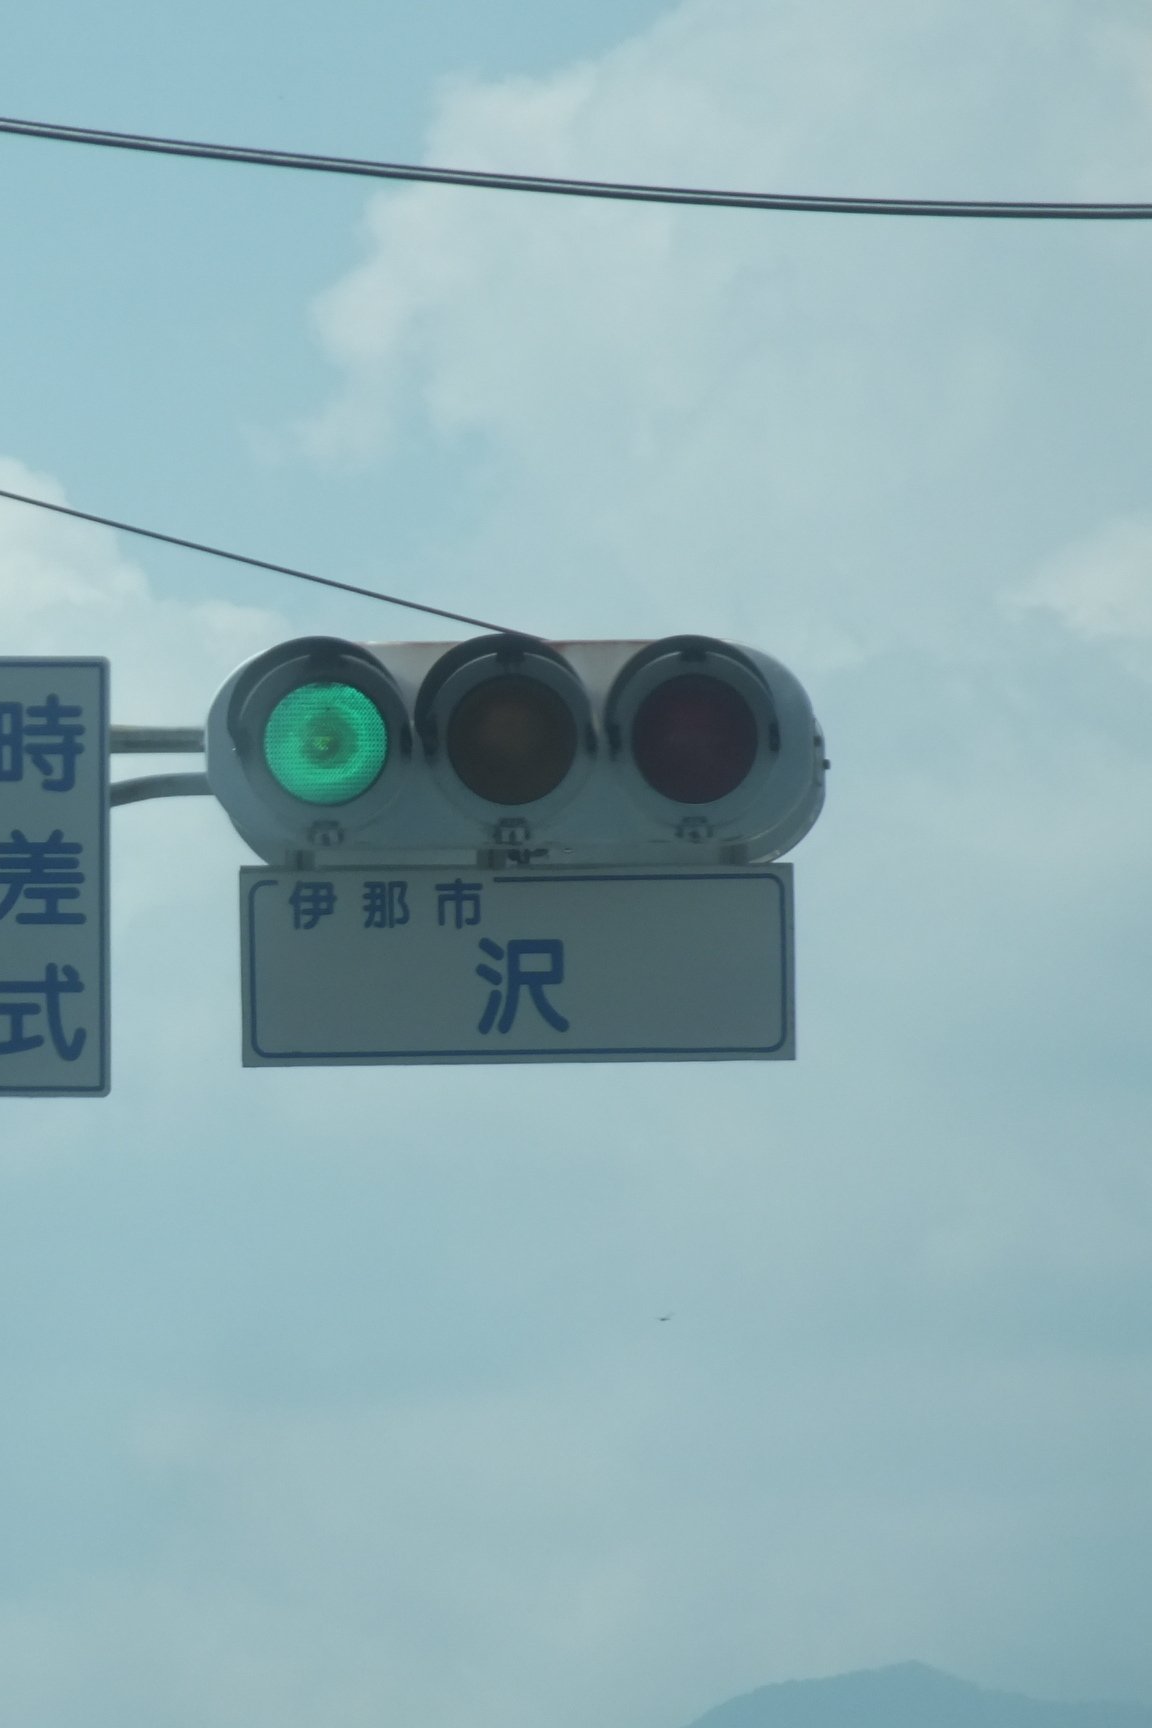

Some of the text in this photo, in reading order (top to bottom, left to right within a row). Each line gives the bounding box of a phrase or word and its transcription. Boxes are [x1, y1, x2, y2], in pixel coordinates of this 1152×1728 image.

[288, 878, 484, 930] 伊那市
[475, 937, 570, 1035] 沢
